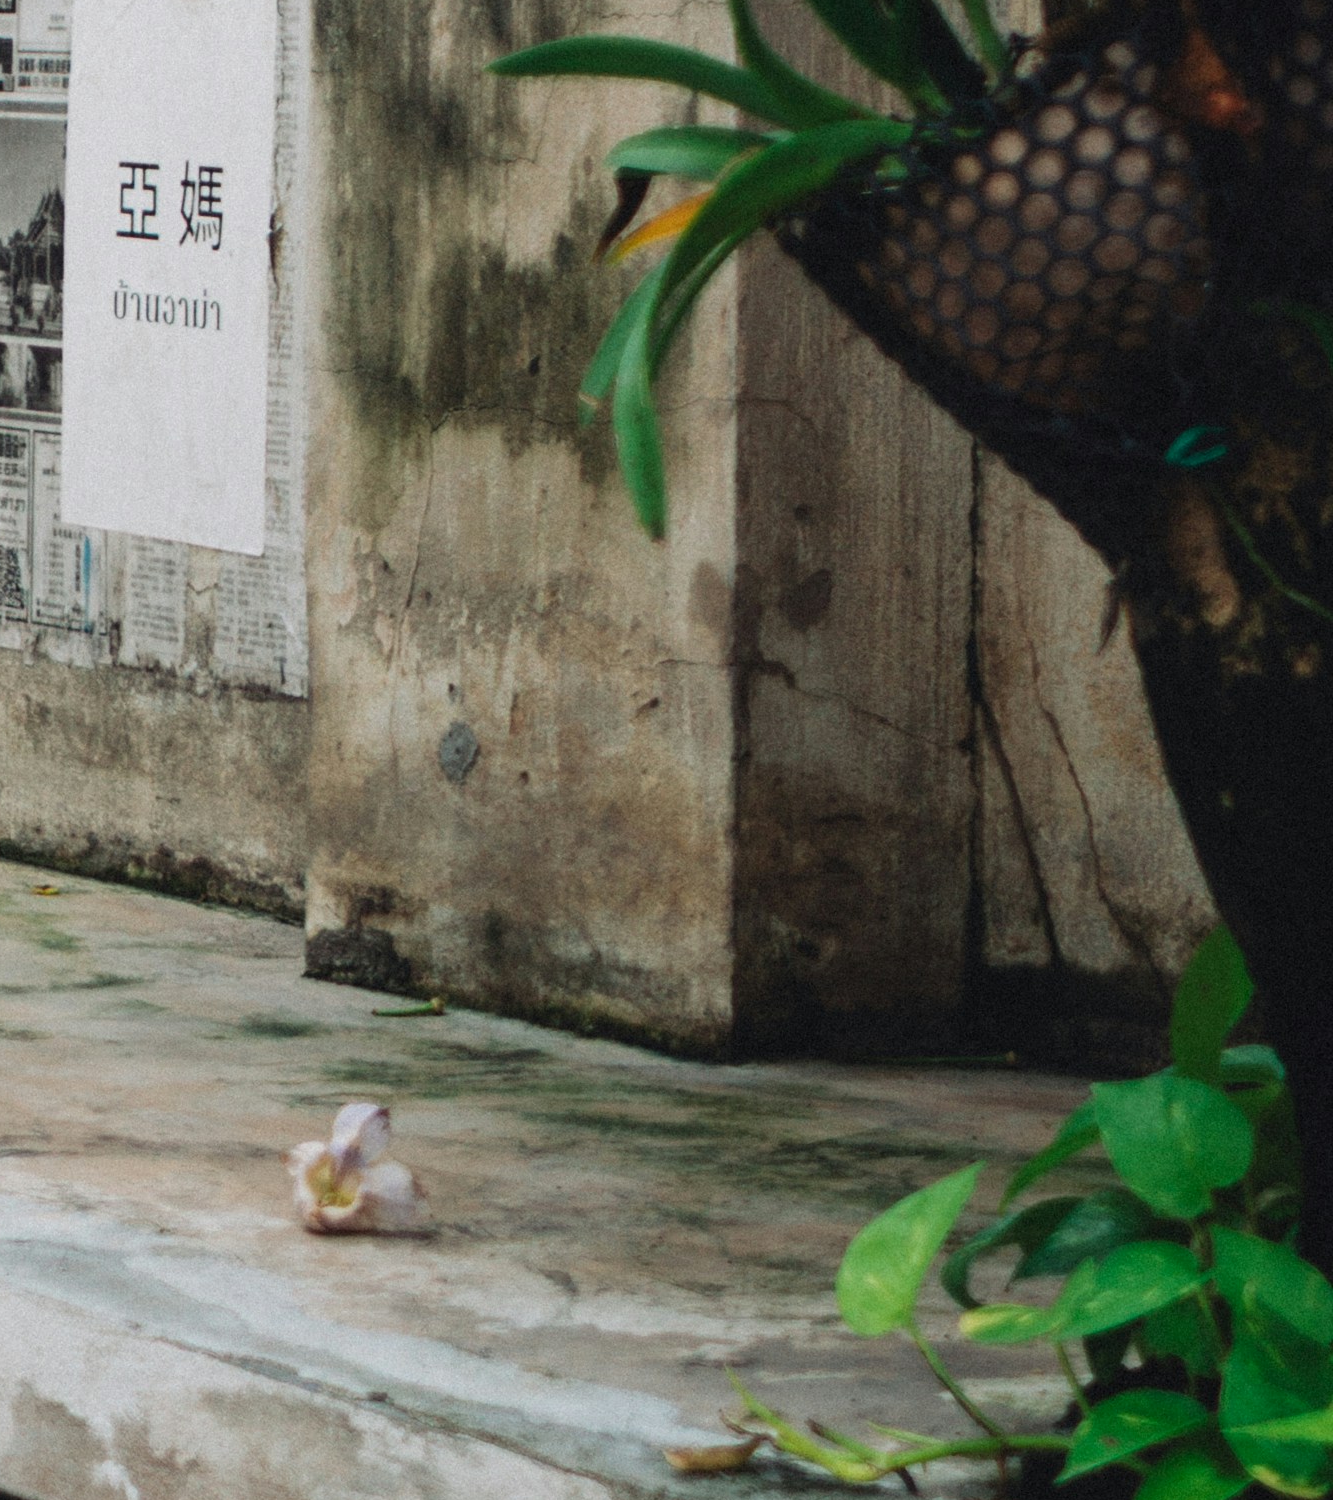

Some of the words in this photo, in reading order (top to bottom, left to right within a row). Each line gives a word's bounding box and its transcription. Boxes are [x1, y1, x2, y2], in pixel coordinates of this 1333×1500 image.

[115, 161, 224, 250] 亞媽
[113, 281, 222, 333] บ้านอาม่า
